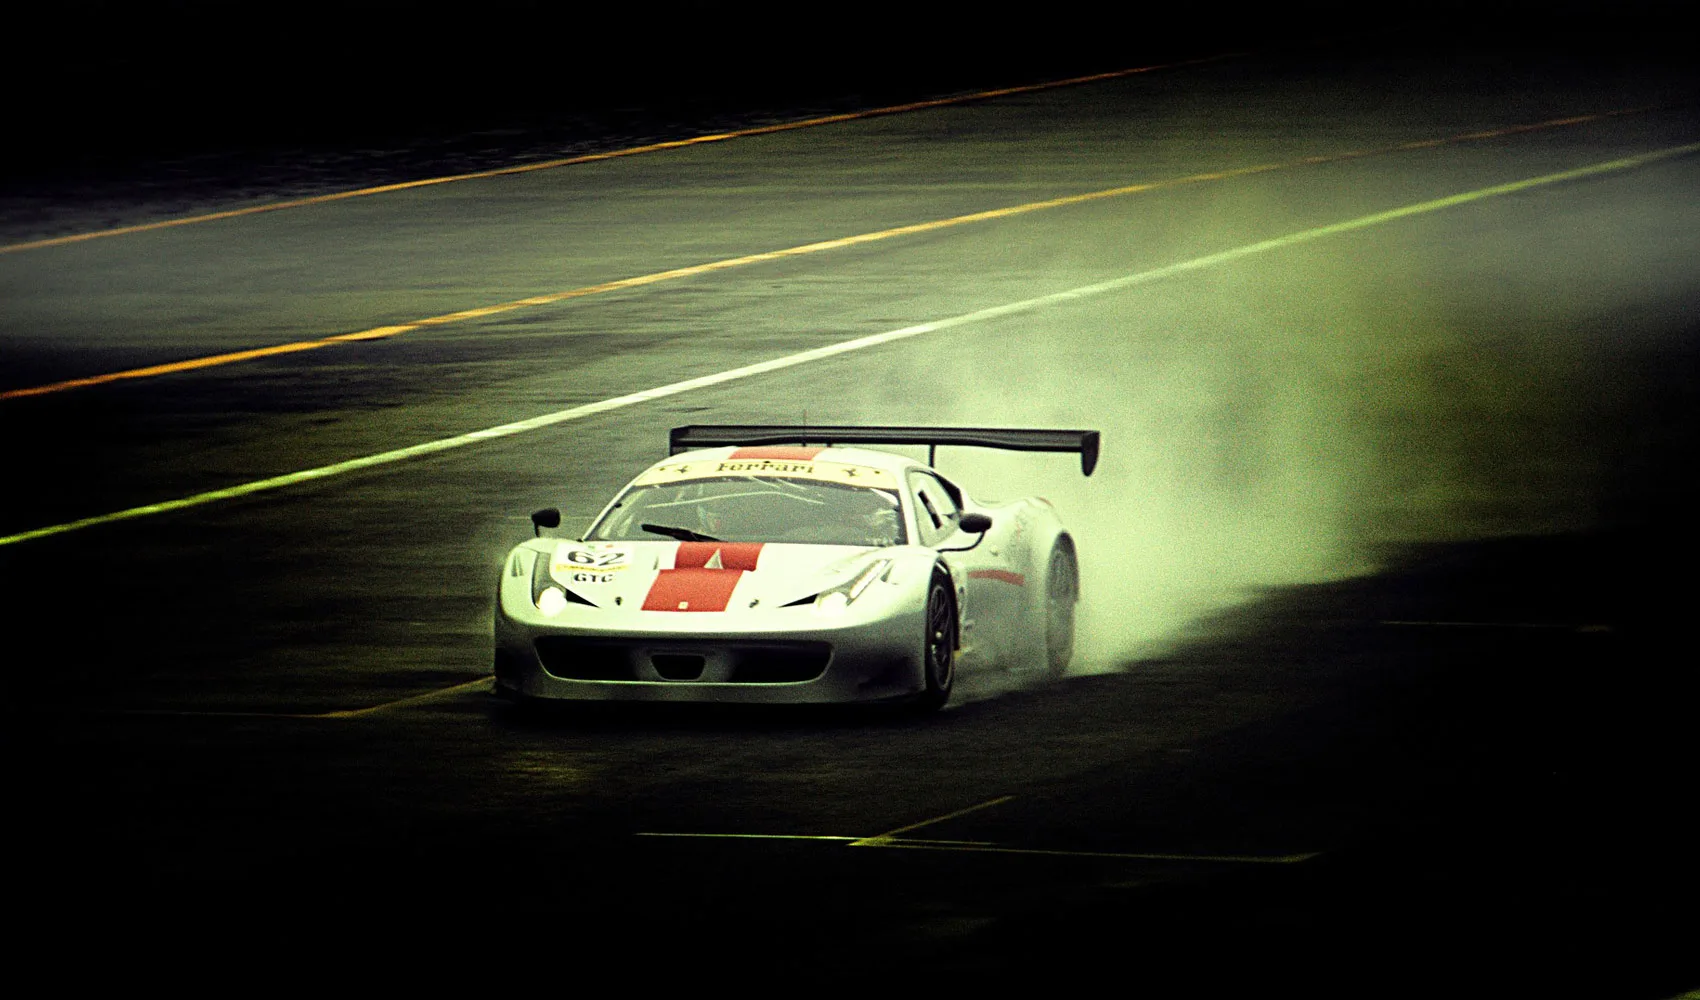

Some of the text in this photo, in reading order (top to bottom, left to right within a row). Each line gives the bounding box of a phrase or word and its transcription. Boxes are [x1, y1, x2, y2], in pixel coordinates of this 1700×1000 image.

[717, 462, 814, 474] Ferrari
[567, 551, 625, 567] 62
[573, 573, 613, 583] GTC
